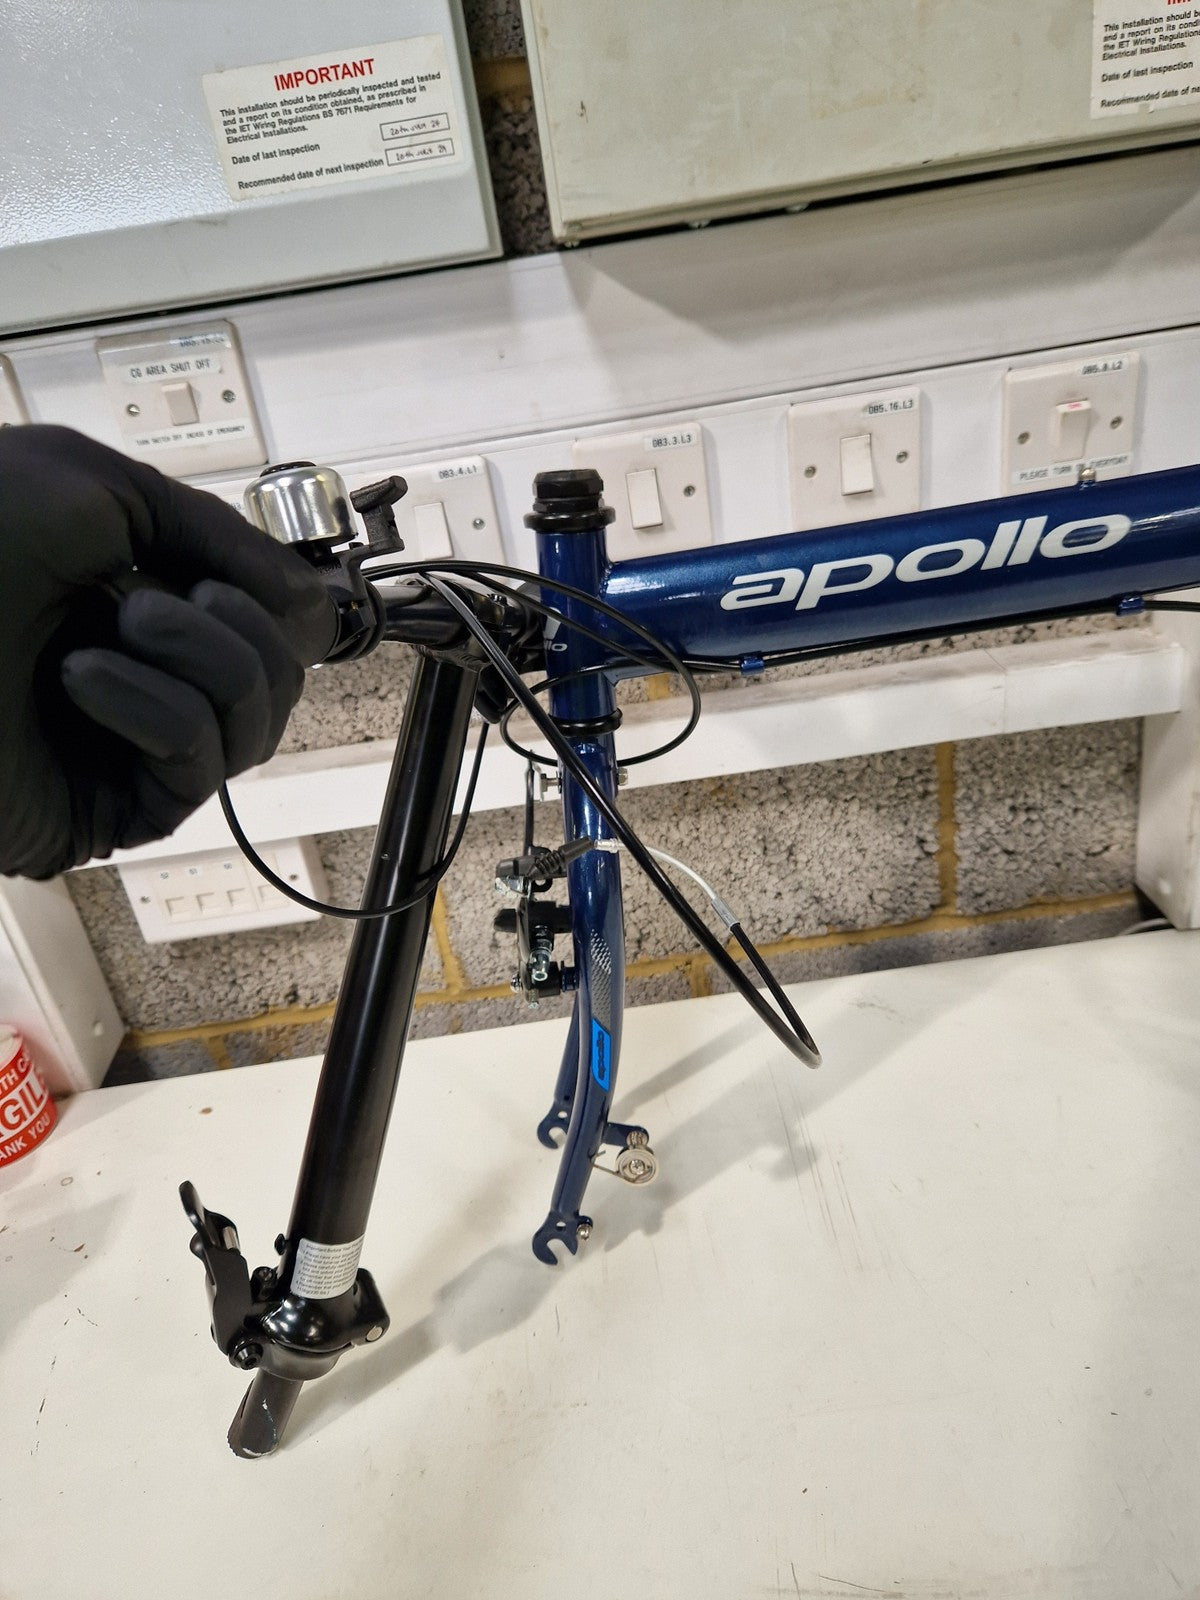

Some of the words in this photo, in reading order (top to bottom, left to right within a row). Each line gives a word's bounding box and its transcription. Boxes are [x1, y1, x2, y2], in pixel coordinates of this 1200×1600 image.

[1104, 24, 1119, 32] This
[1122, 17, 1163, 29] installation
[1166, 10, 1191, 22] should
[1103, 33, 1117, 42] and
[1128, 28, 1151, 39] report
[1103, 43, 1115, 51] the
[1118, 40, 1130, 48] IET
[1133, 36, 1156, 46] Wiring
[1102, 48, 1137, 61] Electrical
[1140, 41, 1186, 54] Installations.
[274, 58, 375, 91] IMPORTANT
[1101, 73, 1120, 82] Date
[1122, 69, 1131, 78] of
[1133, 68, 1148, 77] last
[1150, 61, 1193, 74] inspection
[220, 108, 236, 117] This
[238, 102, 278, 114] installation
[280, 96, 304, 107] should
[318, 86, 360, 101] periodically
[362, 79, 398, 92] inspected
[401, 76, 415, 86] and
[416, 71, 441, 83] tested
[222, 117, 237, 126] and
[246, 111, 269, 123] report
[282, 108, 292, 116] its
[294, 102, 328, 114] condition
[330, 95, 364, 107] obtained,
[378, 86, 417, 101] prescribed
[419, 84, 426, 92] in
[1101, 92, 1160, 108] Recommended
[1162, 89, 1178, 98] date
[1181, 86, 1190, 95] of
[225, 127, 237, 135] the
[239, 124, 250, 132] IET
[253, 120, 276, 131] Wiring
[278, 113, 320, 126] Regulations
[322, 110, 334, 118] BS
[335, 107, 352, 116] 7671
[354, 99, 403, 113] Requirements
[405, 96, 416, 104] for
[226, 132, 261, 144] Electrical
[262, 125, 308, 138] Installations.
[232, 155, 250, 165] Date
[252, 153, 260, 162] of
[262, 151, 277, 160] last
[278, 143, 320, 157] inspection
[238, 172, 296, 190] Recommended
[297, 170, 314, 180] date
[315, 168, 324, 176] of
[325, 166, 342, 175] next
[344, 158, 384, 172] inspection
[146, 364, 168, 376] AREA
[170, 361, 191, 373] SHUT
[720, 514, 1132, 611] apollo
[28, 1111, 50, 1139] YOU
